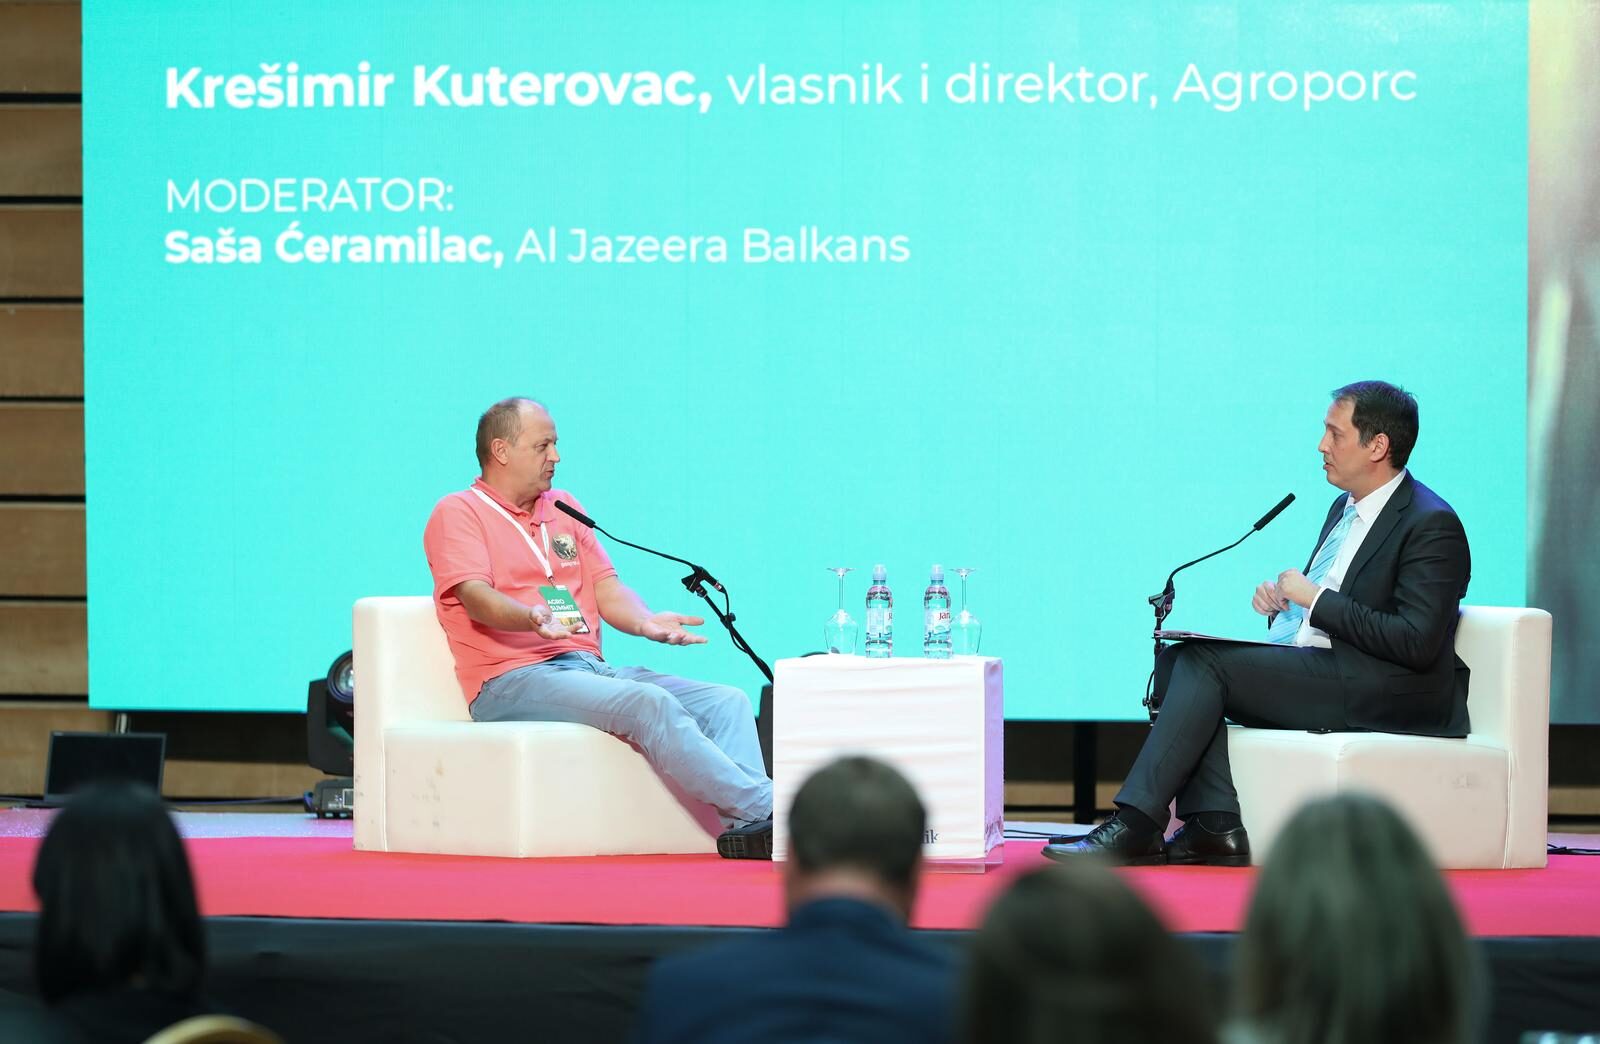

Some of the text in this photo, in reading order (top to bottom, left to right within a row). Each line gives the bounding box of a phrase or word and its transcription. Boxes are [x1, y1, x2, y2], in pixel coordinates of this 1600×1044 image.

[165, 61, 1418, 114] Krešimir Kuterovac, vlasnik i direktor, Agroporc
[166, 177, 454, 213] MODERATOR:
[165, 221, 910, 269] Saša Ćeramilac, Al Jazeera Balkans
